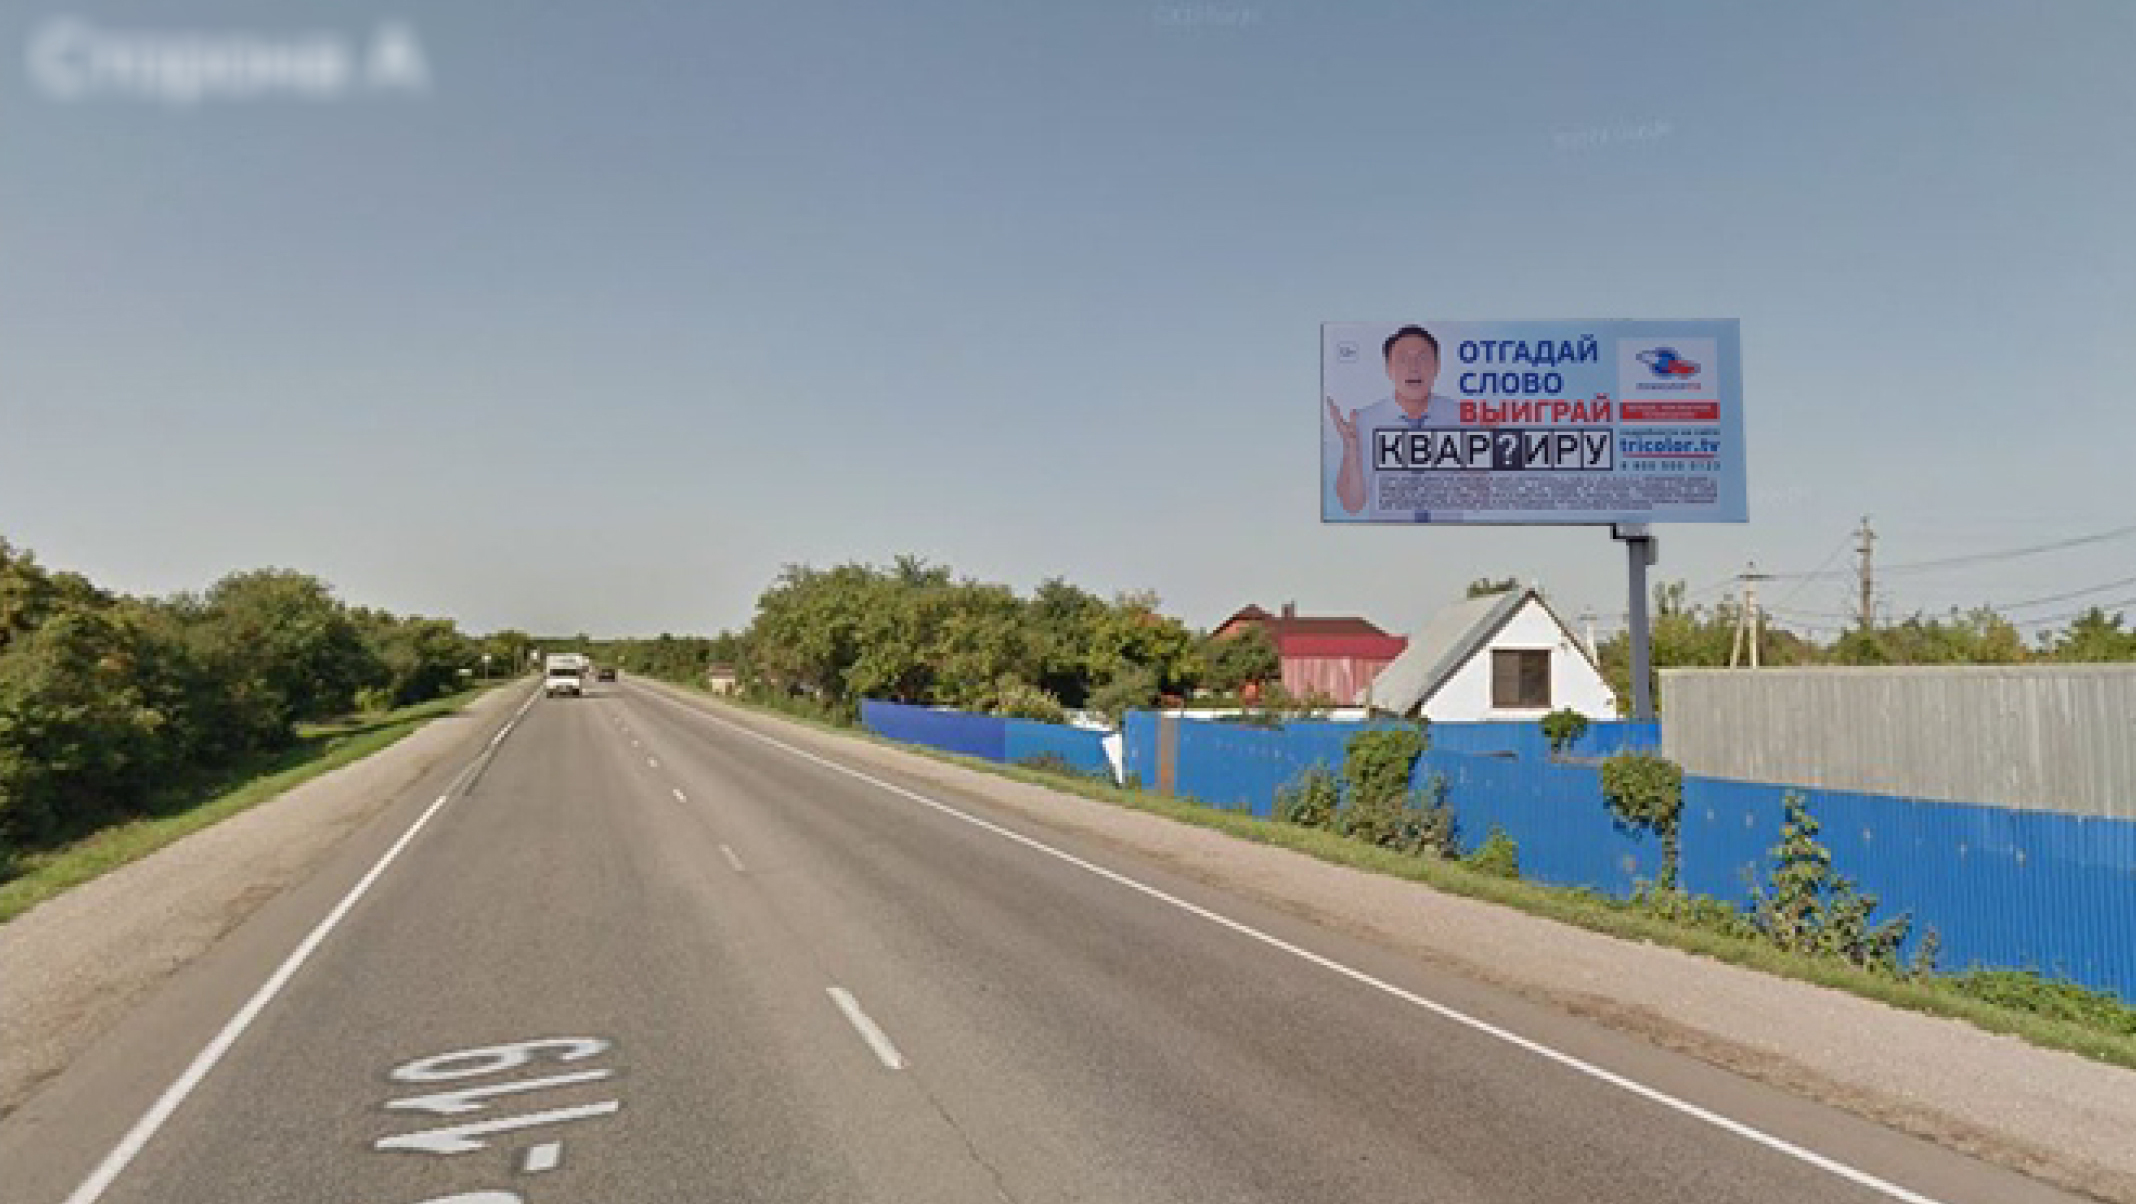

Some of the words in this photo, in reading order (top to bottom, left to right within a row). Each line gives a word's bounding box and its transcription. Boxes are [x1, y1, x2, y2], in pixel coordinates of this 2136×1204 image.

[1458, 334, 1598, 367] ОТГАДАЙ
[1458, 372, 1563, 395] СЛОВО
[1459, 393, 1613, 423] ВЫИГРАЙ
[1379, 434, 1608, 466] КВАР?ИРУ
[1619, 436, 1721, 452] tricolor.tv
